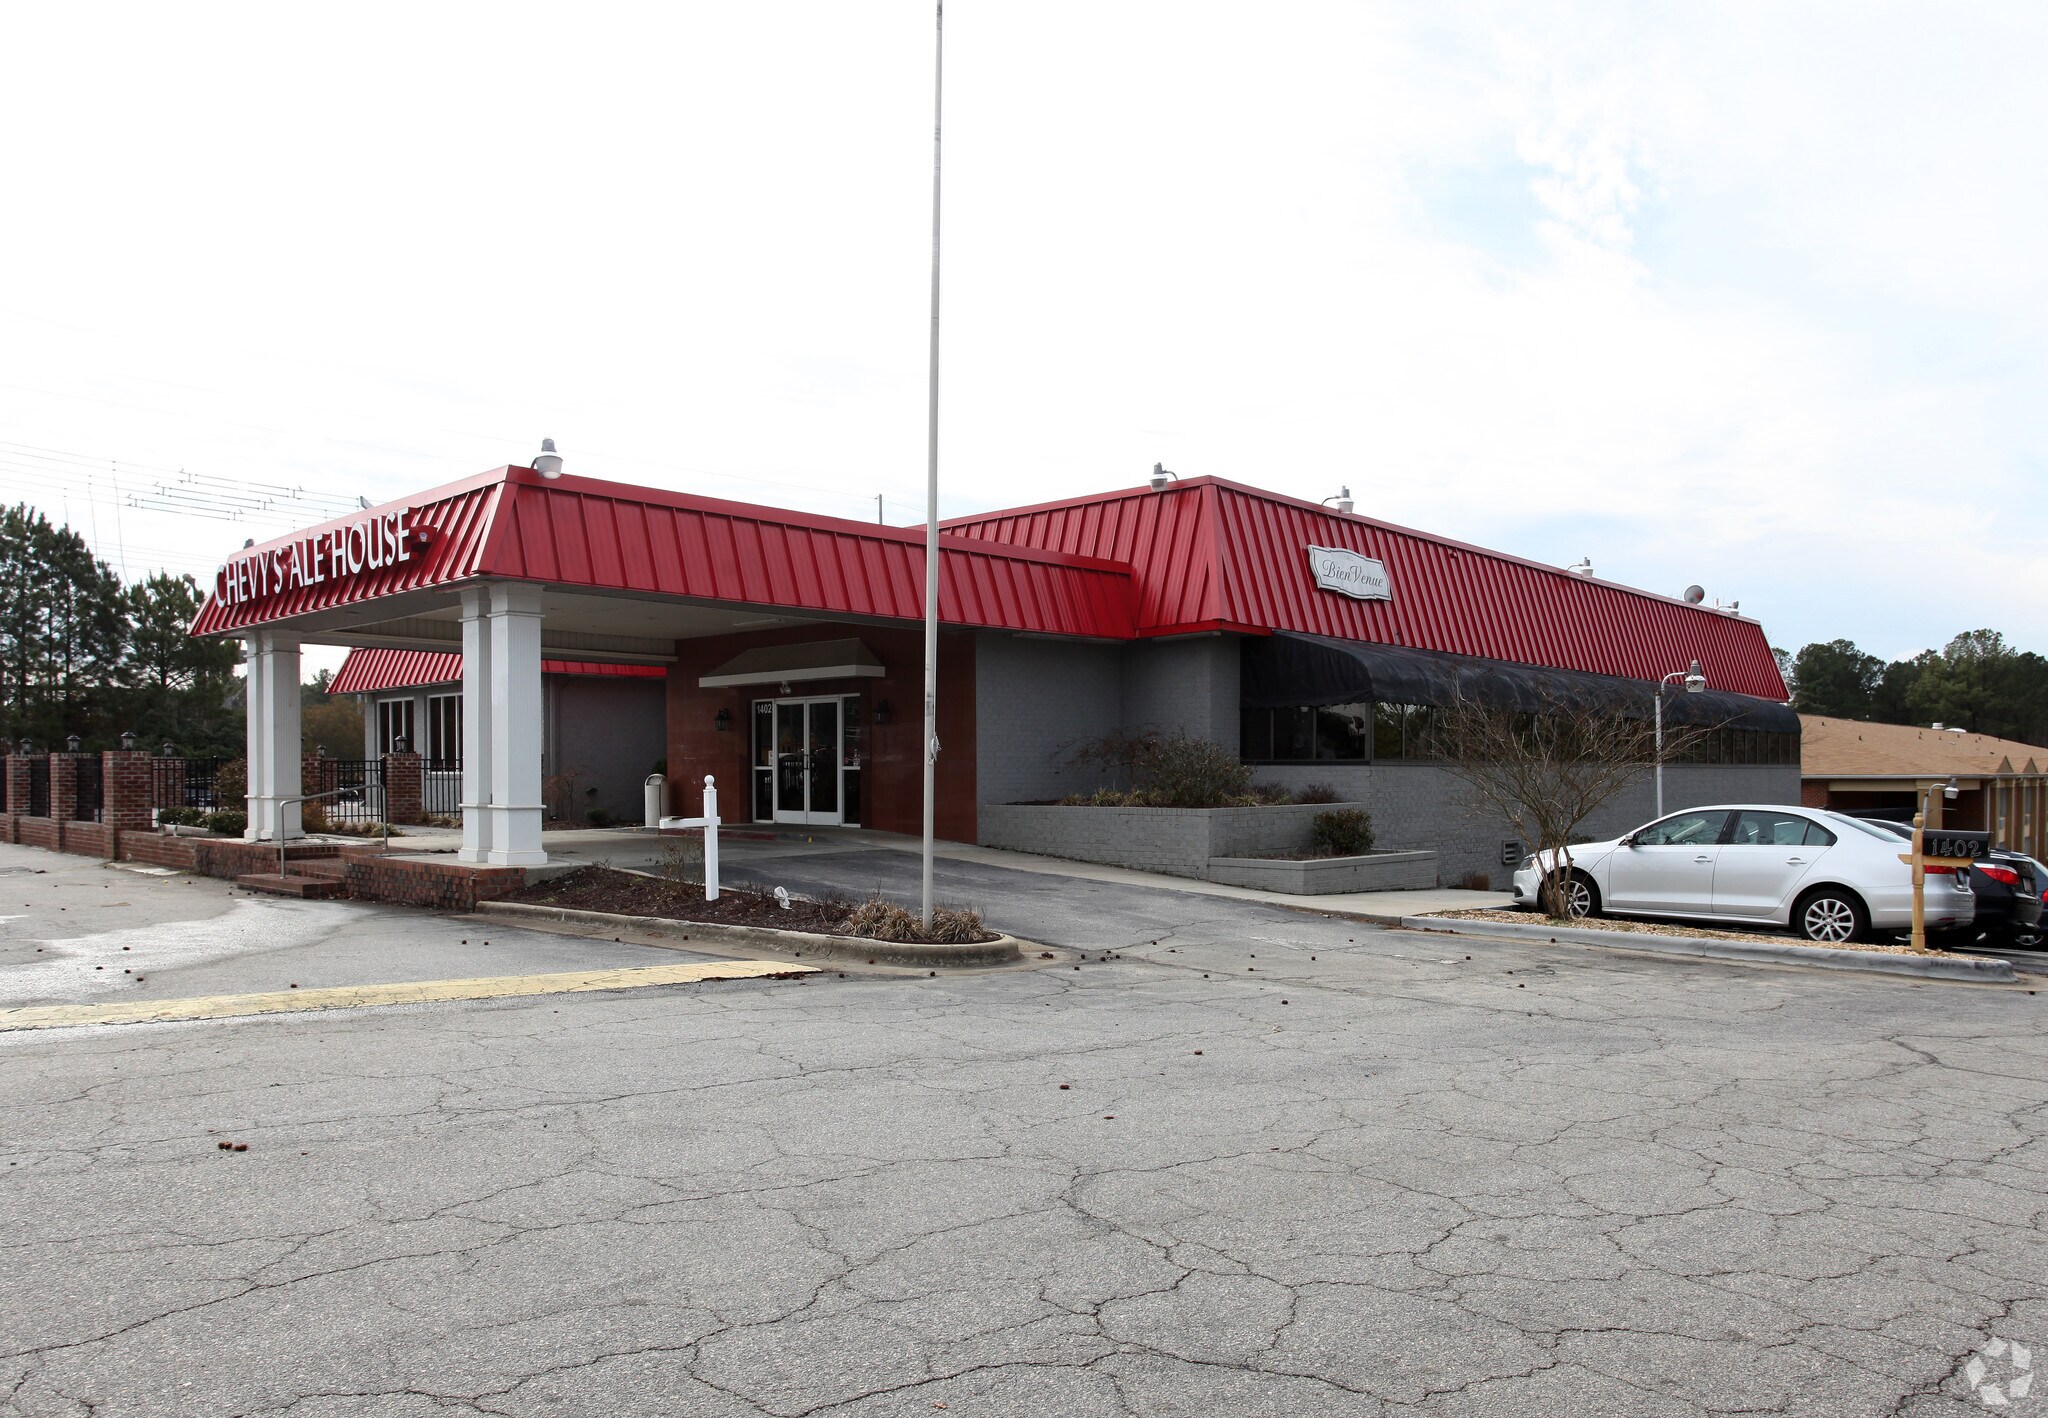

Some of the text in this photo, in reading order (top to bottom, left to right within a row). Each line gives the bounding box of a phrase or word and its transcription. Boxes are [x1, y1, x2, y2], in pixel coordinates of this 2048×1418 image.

[289, 533, 325, 590] ALE
[331, 507, 410, 579] HOUSE
[756, 703, 772, 715] 1402
[1932, 838, 1981, 857] 1402
